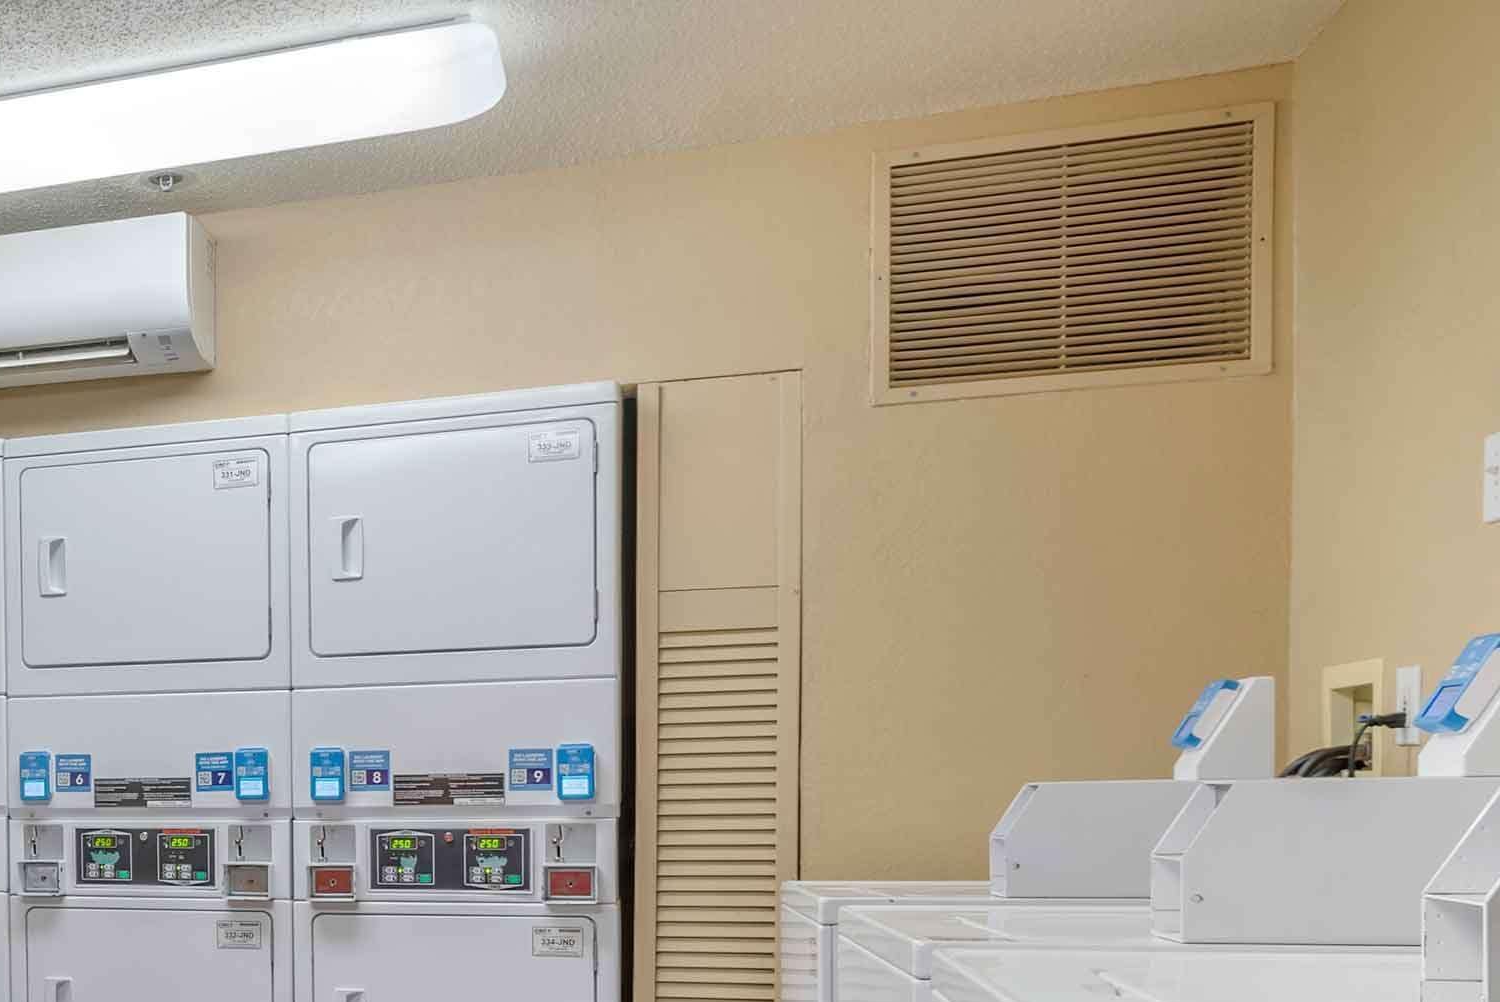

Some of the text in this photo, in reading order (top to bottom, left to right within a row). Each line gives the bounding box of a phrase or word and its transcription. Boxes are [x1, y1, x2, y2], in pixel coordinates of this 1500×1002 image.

[75, 773, 84, 785] 6
[217, 772, 226, 784] 7
[372, 771, 382, 784] 8
[534, 770, 544, 783] 9
